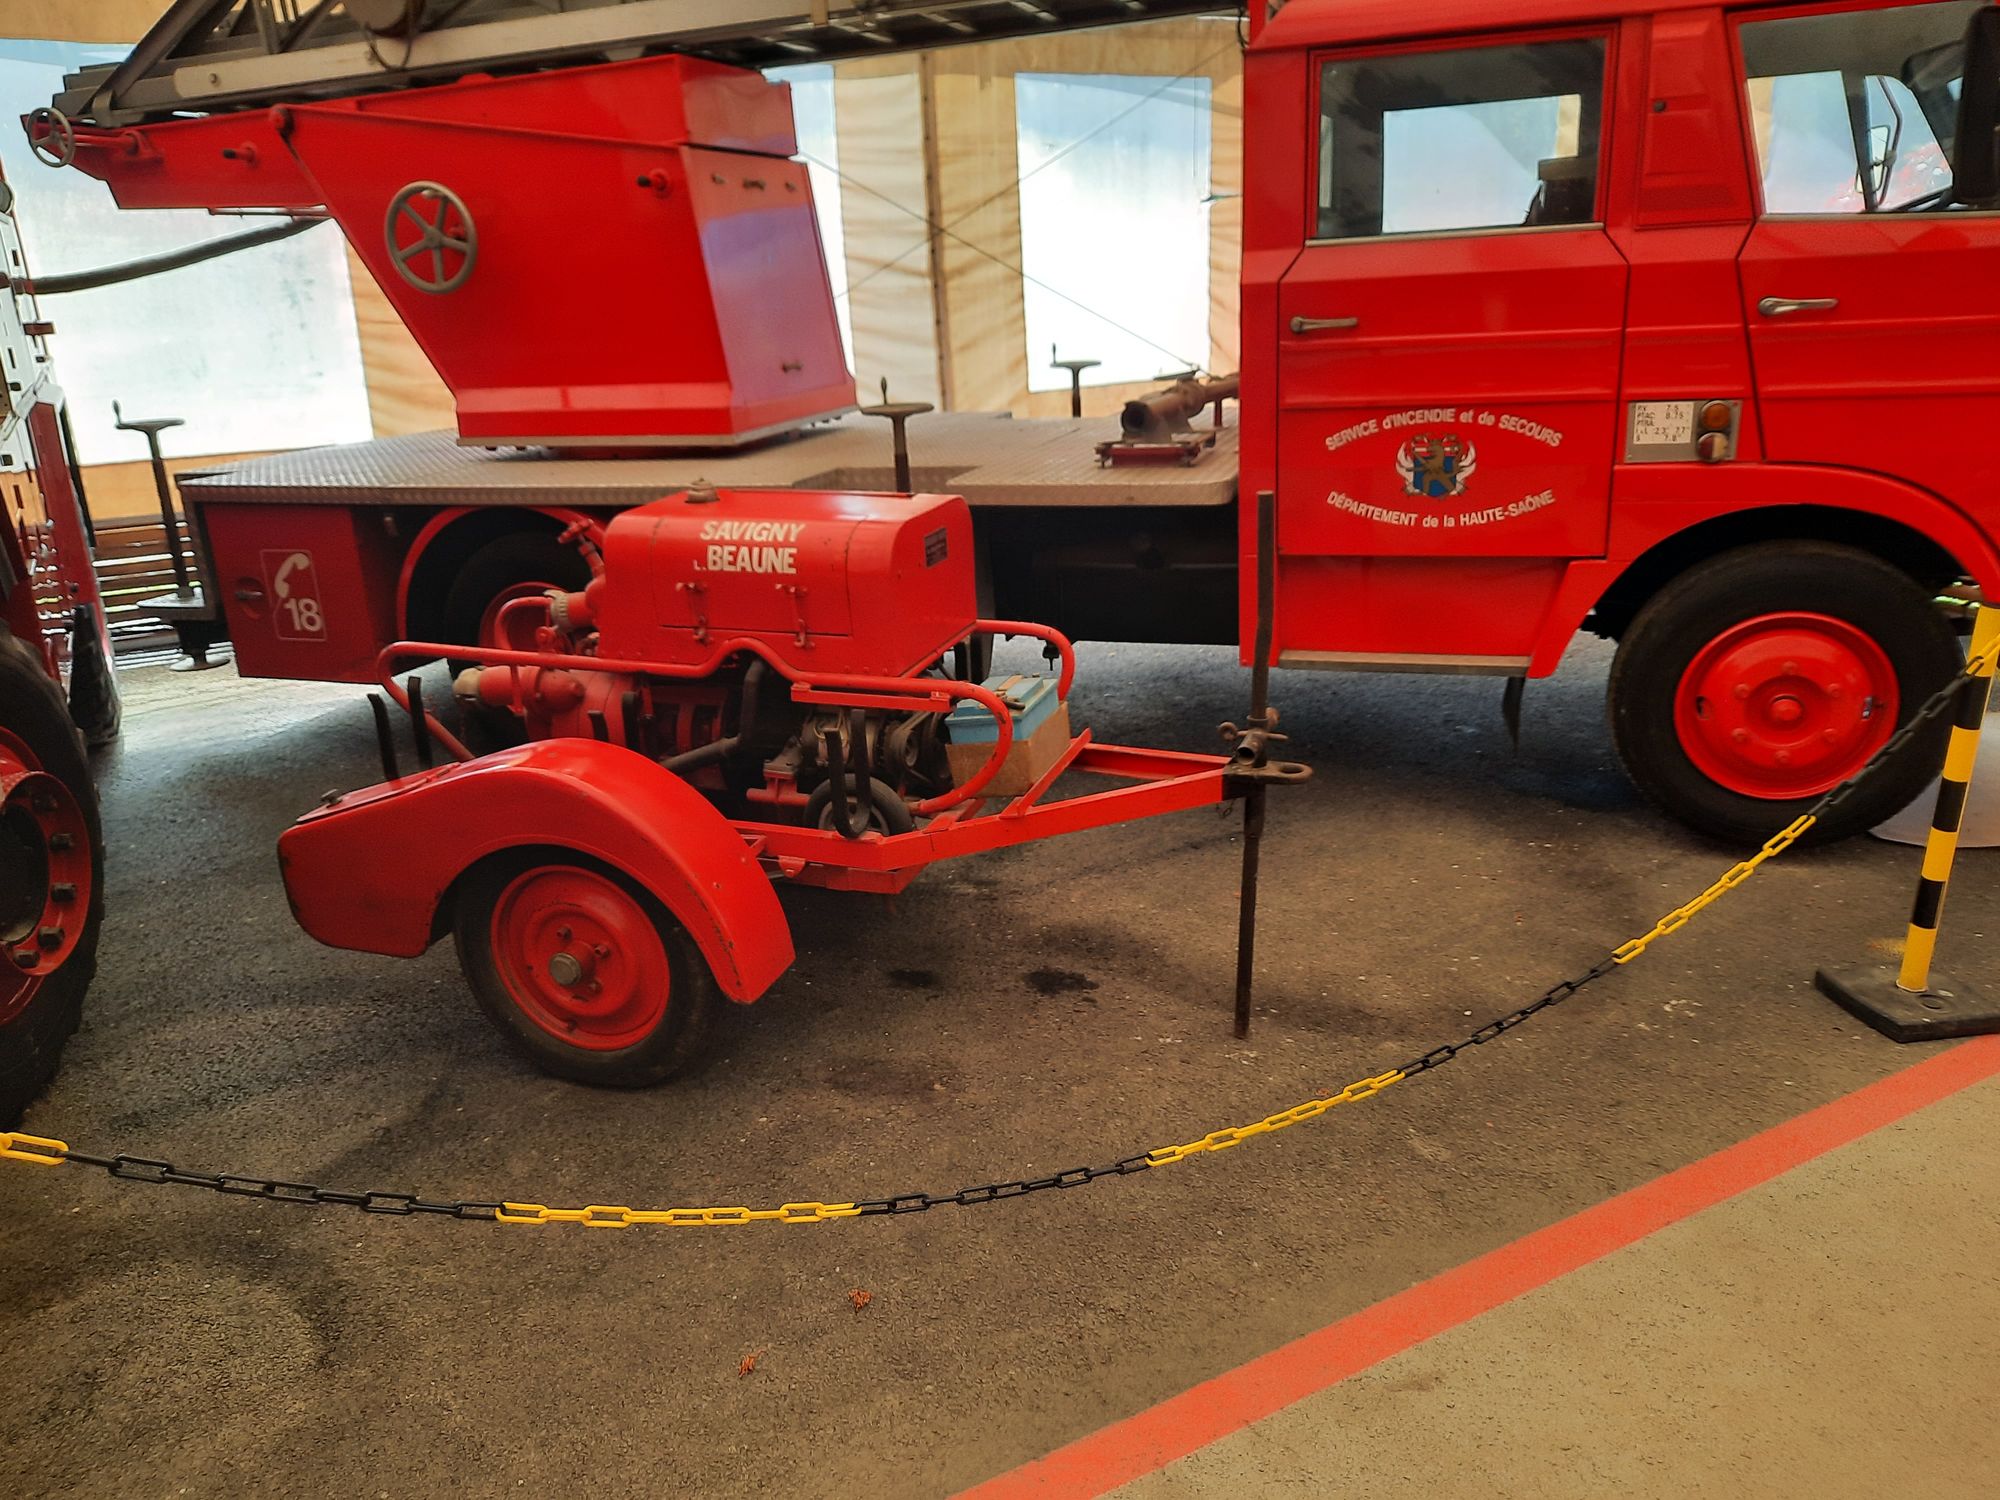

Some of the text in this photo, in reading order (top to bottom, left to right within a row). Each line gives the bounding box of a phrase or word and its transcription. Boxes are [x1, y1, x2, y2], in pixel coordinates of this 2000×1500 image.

[1325, 408, 1562, 451] SERVICE d'INCENDIE et de SECOURS
[1327, 489, 1556, 528] DÉPARTEMENT de la HAUTE-SAÔNE
[700, 520, 805, 543] SAVIGNY
[283, 597, 323, 632] 18
